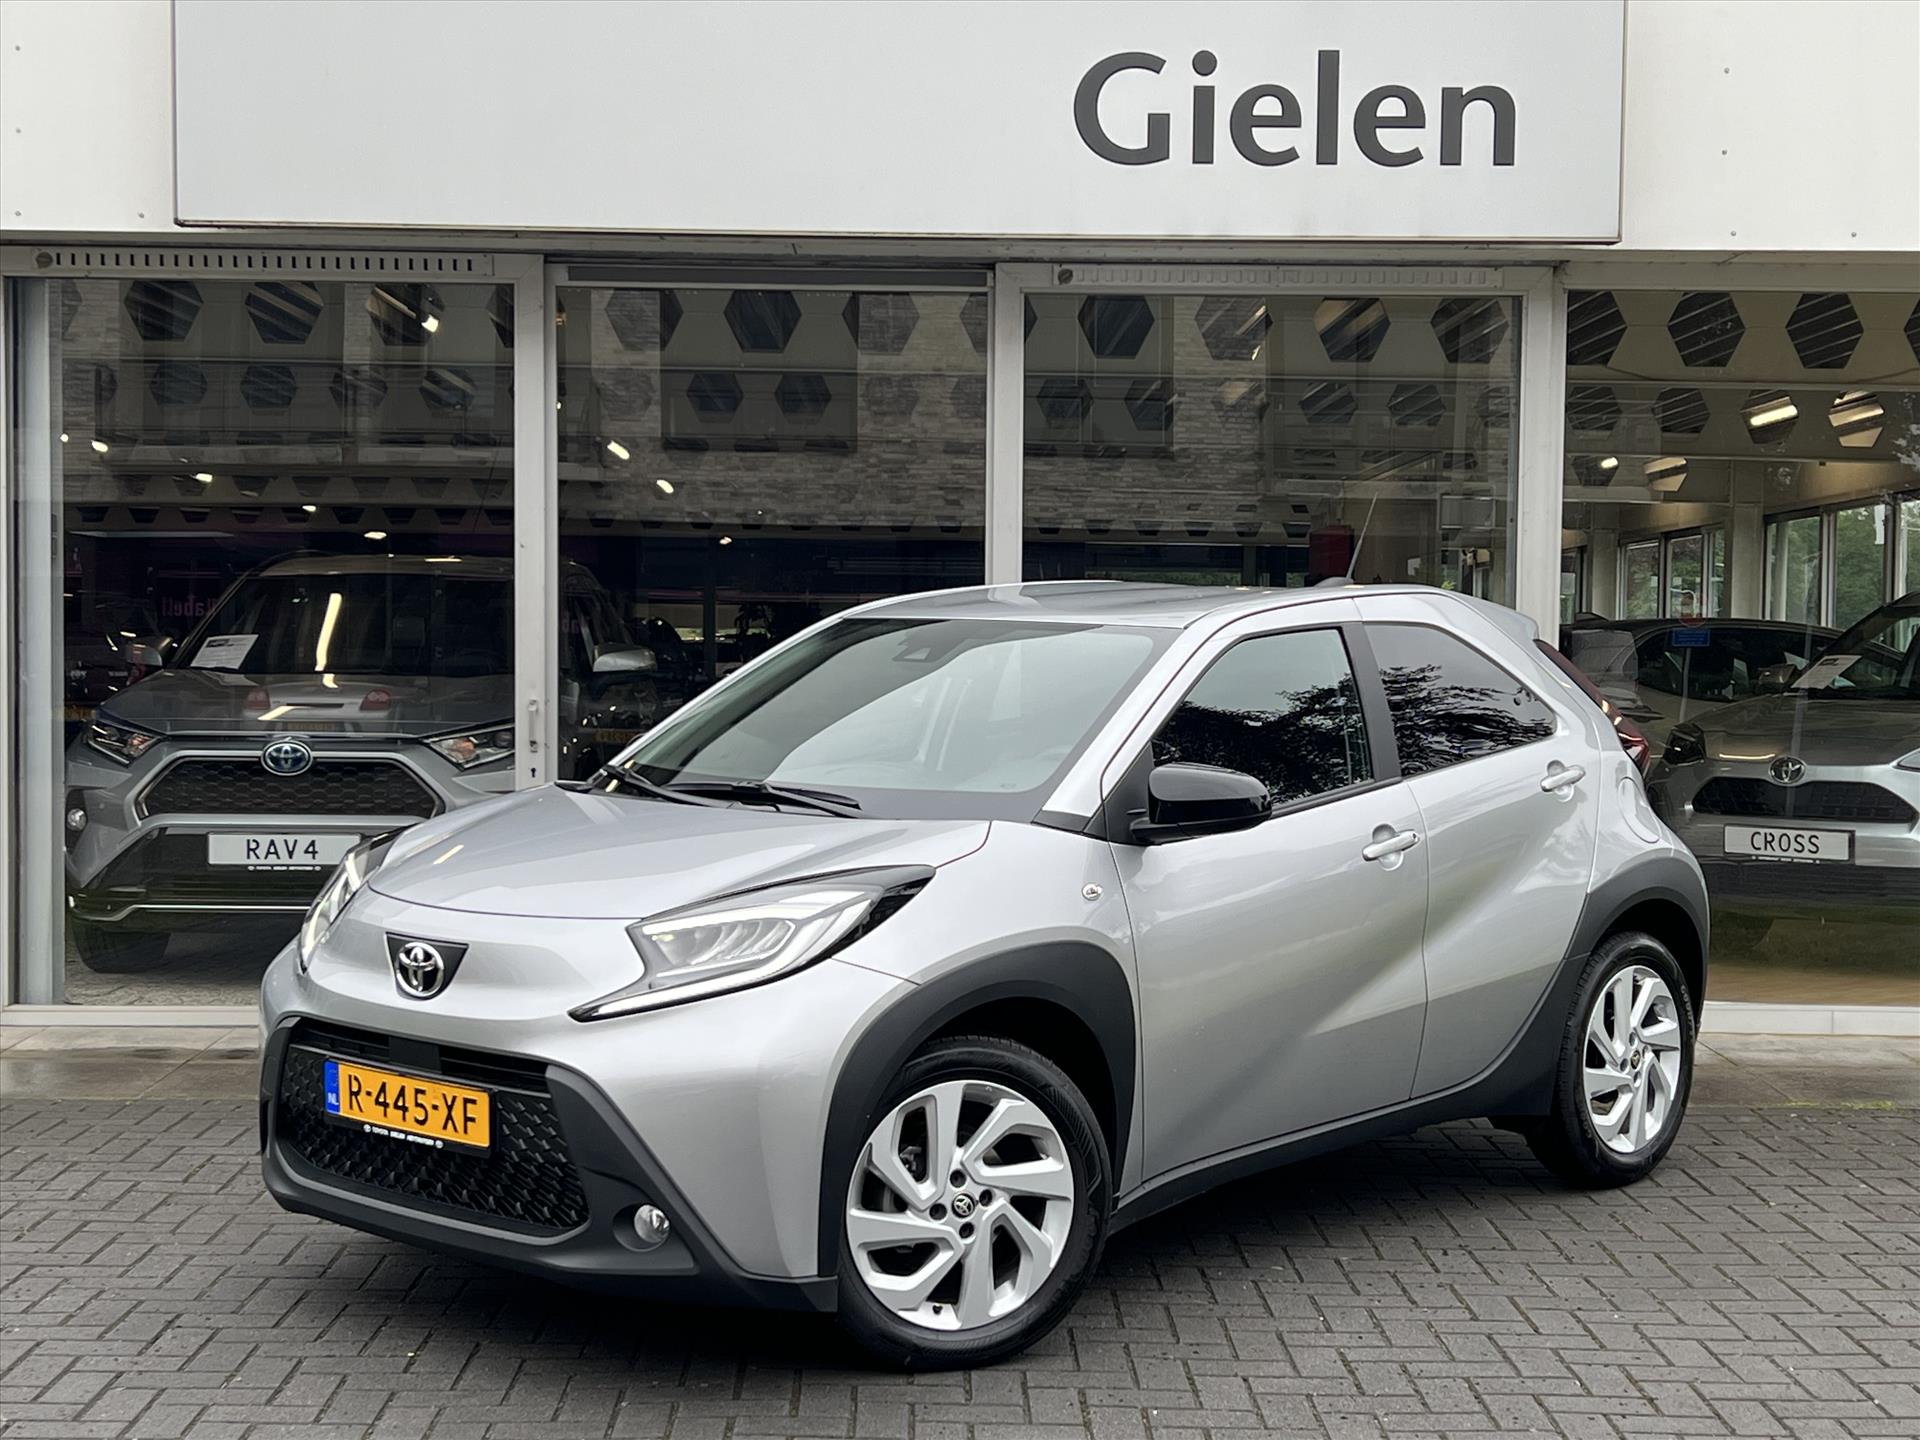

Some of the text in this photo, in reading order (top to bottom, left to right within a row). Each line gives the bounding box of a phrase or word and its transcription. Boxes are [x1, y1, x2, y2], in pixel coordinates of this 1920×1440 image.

[1073, 49, 1516, 167] Gielen
[246, 838, 319, 861] RAV4
[1750, 831, 1820, 854] CROSS
[327, 1092, 340, 1106] NL
[348, 1074, 478, 1135] R-445-XF
